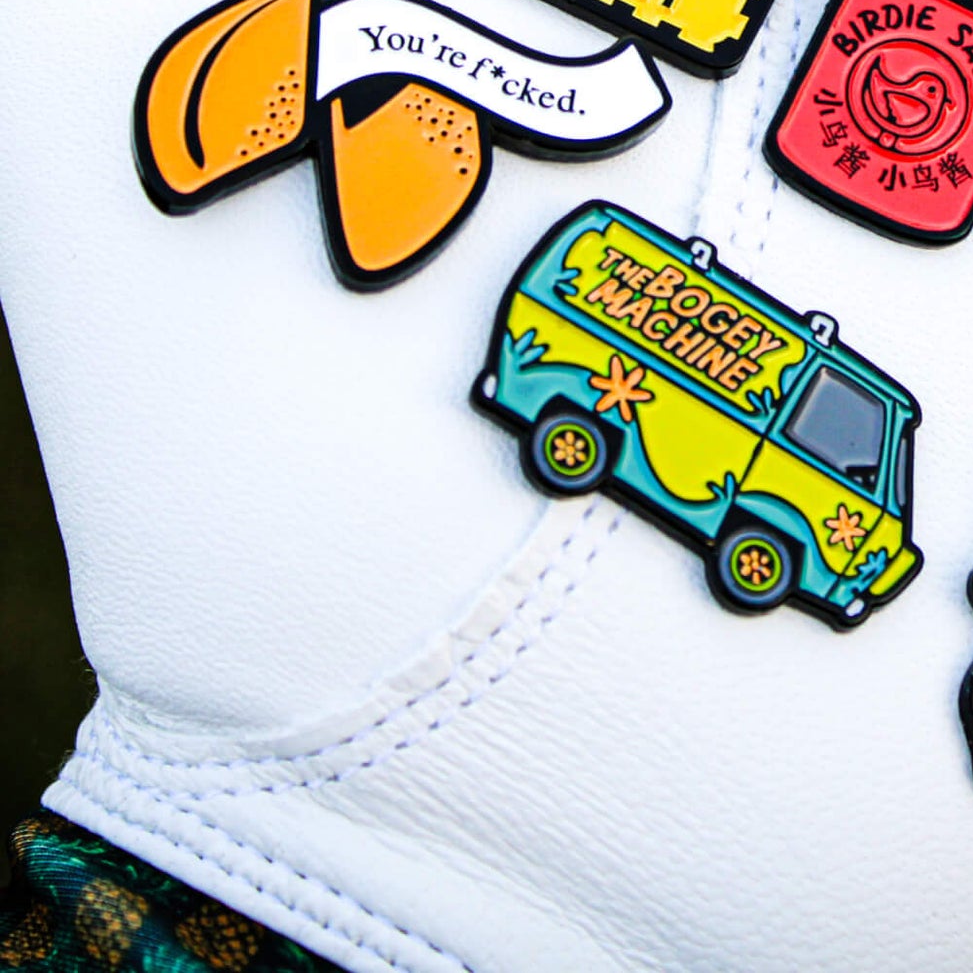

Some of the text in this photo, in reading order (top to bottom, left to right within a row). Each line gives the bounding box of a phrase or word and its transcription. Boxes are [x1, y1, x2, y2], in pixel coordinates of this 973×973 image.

[359, 25, 467, 68] You're
[832, 4, 937, 57] BIRDIE
[587, 278, 760, 391] MACHINE
[599, 247, 783, 360] THE BOGEY
